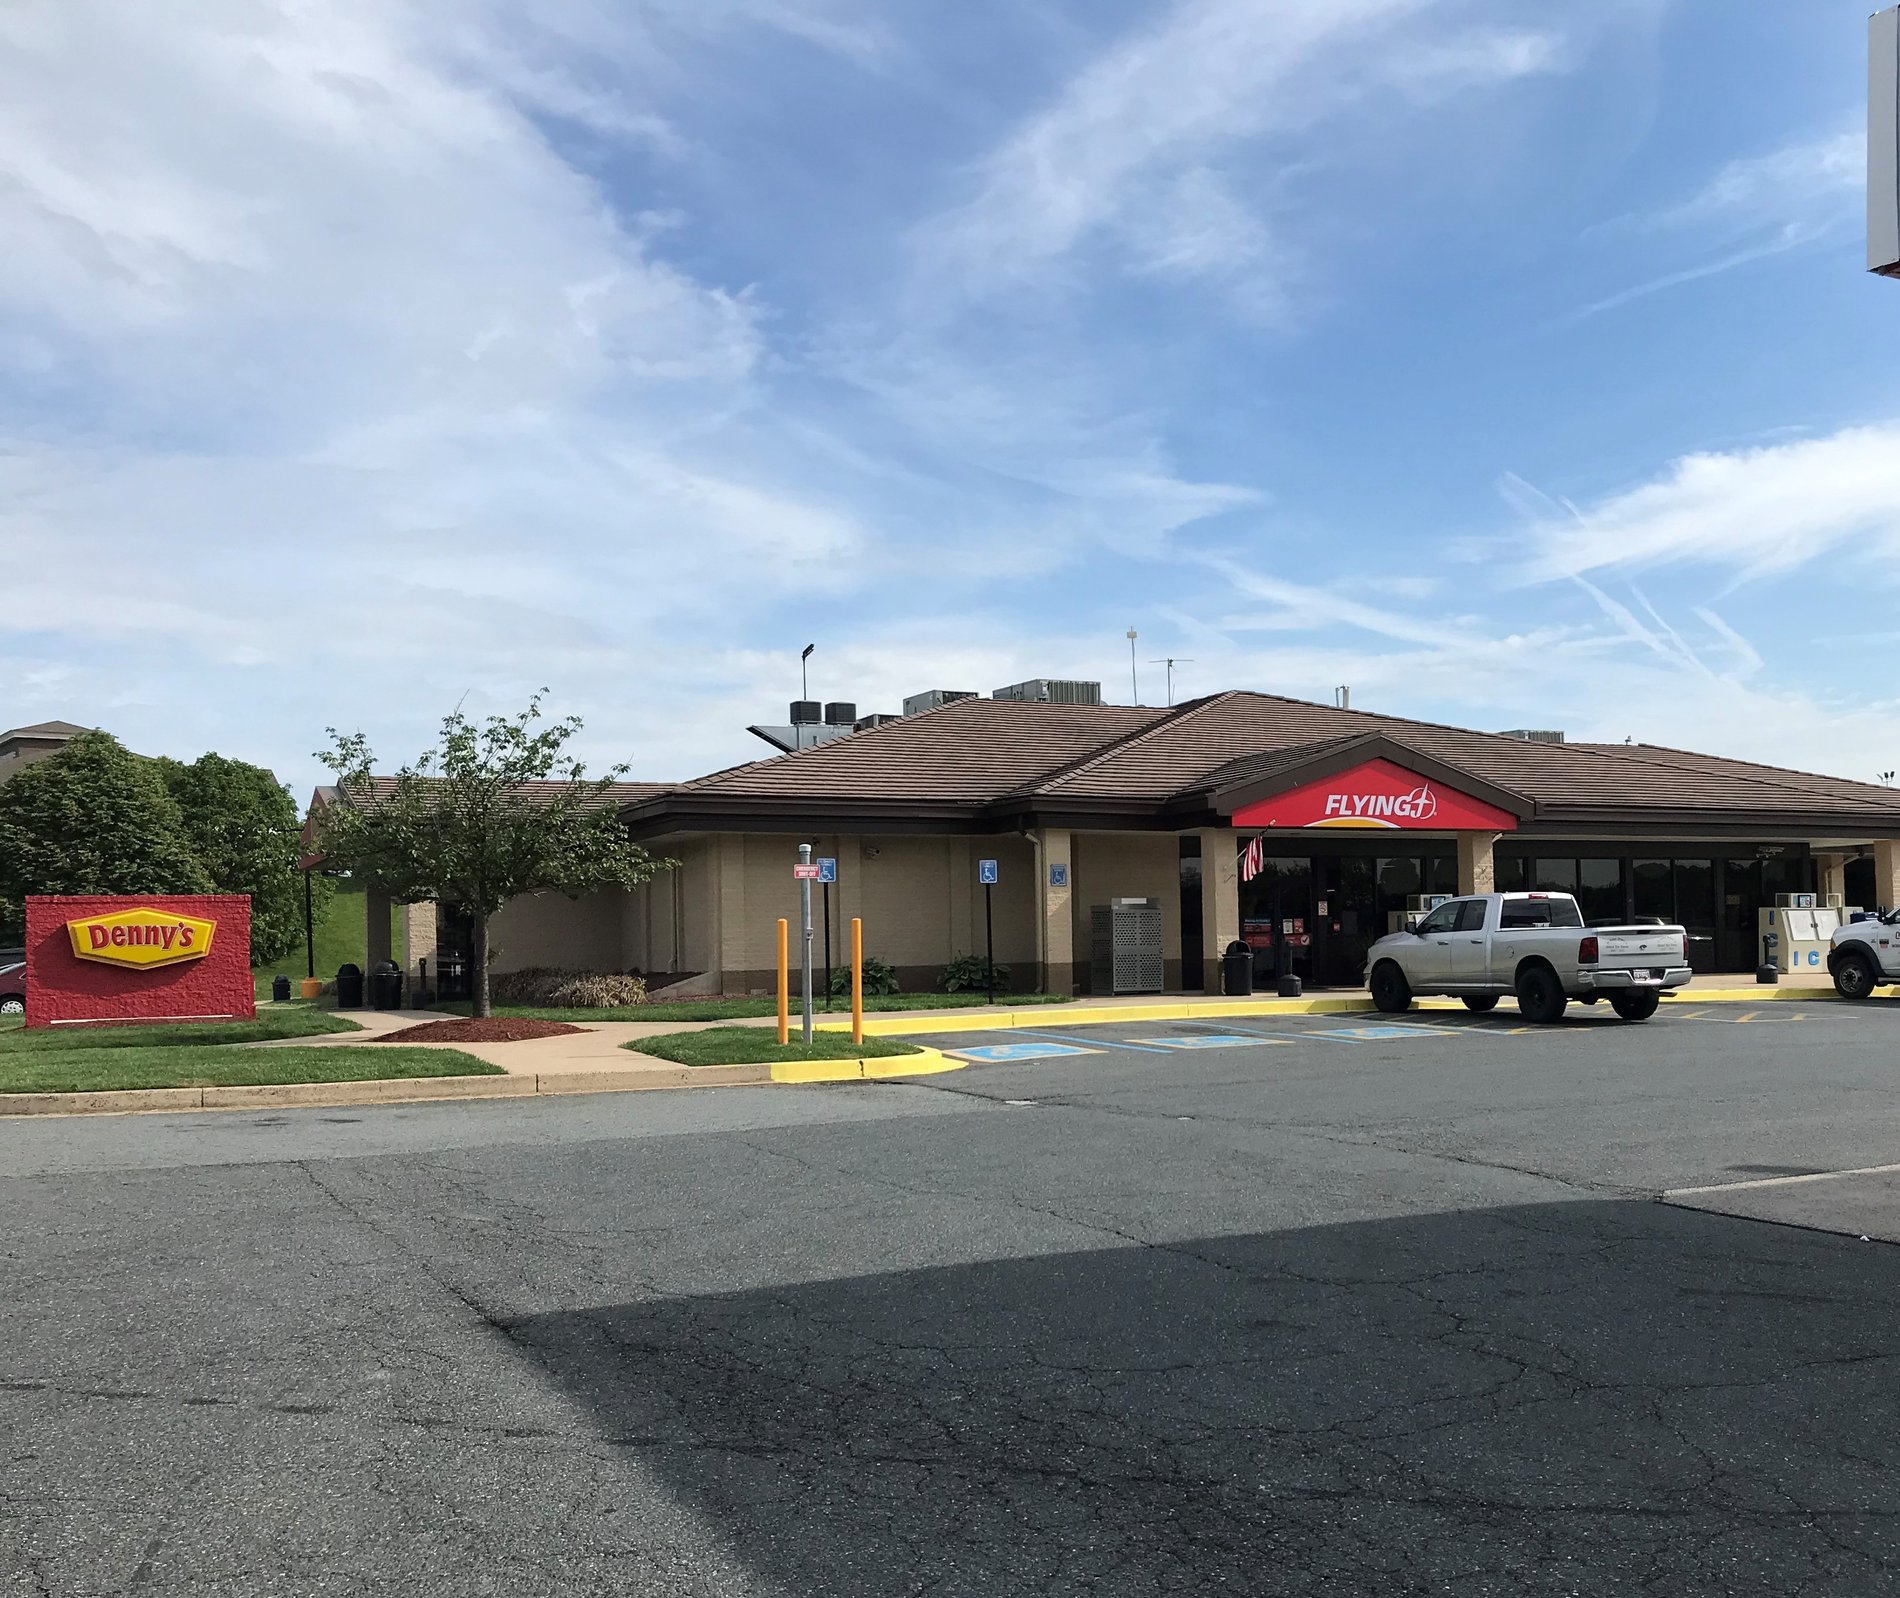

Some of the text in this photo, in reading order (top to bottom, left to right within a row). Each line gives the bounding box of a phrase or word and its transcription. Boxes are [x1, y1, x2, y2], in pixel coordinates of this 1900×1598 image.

[1325, 794, 1411, 816] FLYING
[87, 922, 195, 950] Denny's
[1793, 950, 1819, 966] IC
